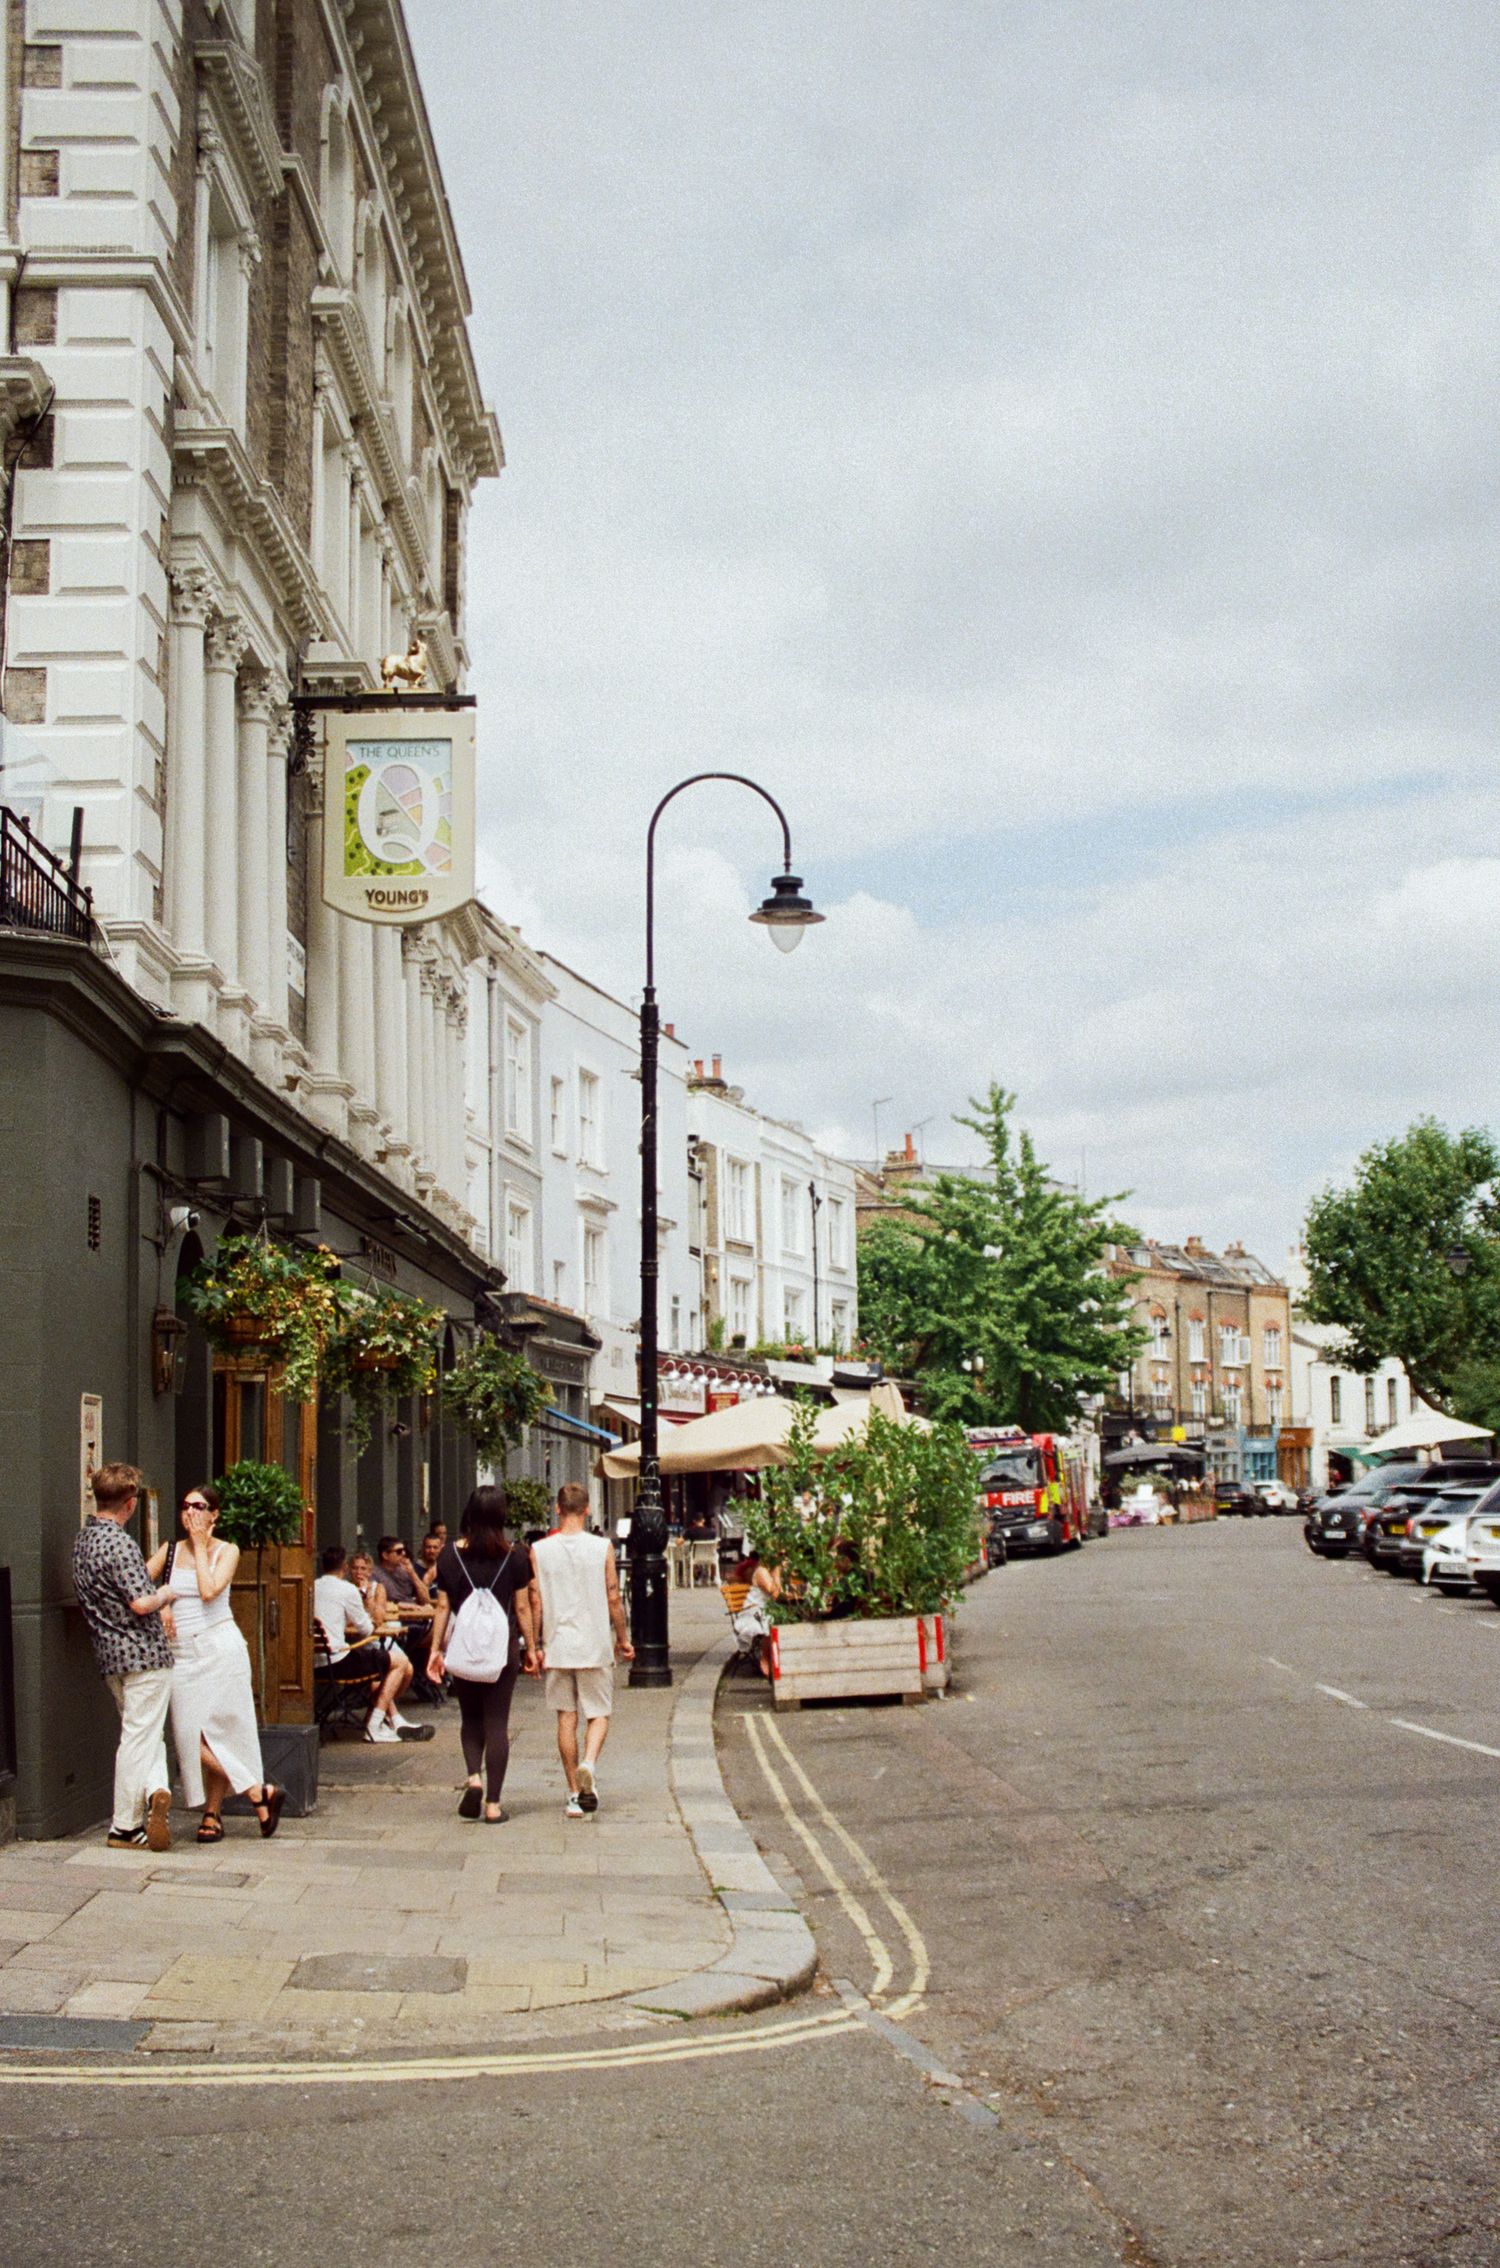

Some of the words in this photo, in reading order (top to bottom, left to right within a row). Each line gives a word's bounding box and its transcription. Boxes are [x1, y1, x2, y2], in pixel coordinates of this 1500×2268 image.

[360, 745, 382, 759] THE
[365, 888, 429, 905] YOUNG'S
[1002, 1488, 1036, 1507] FIRE
